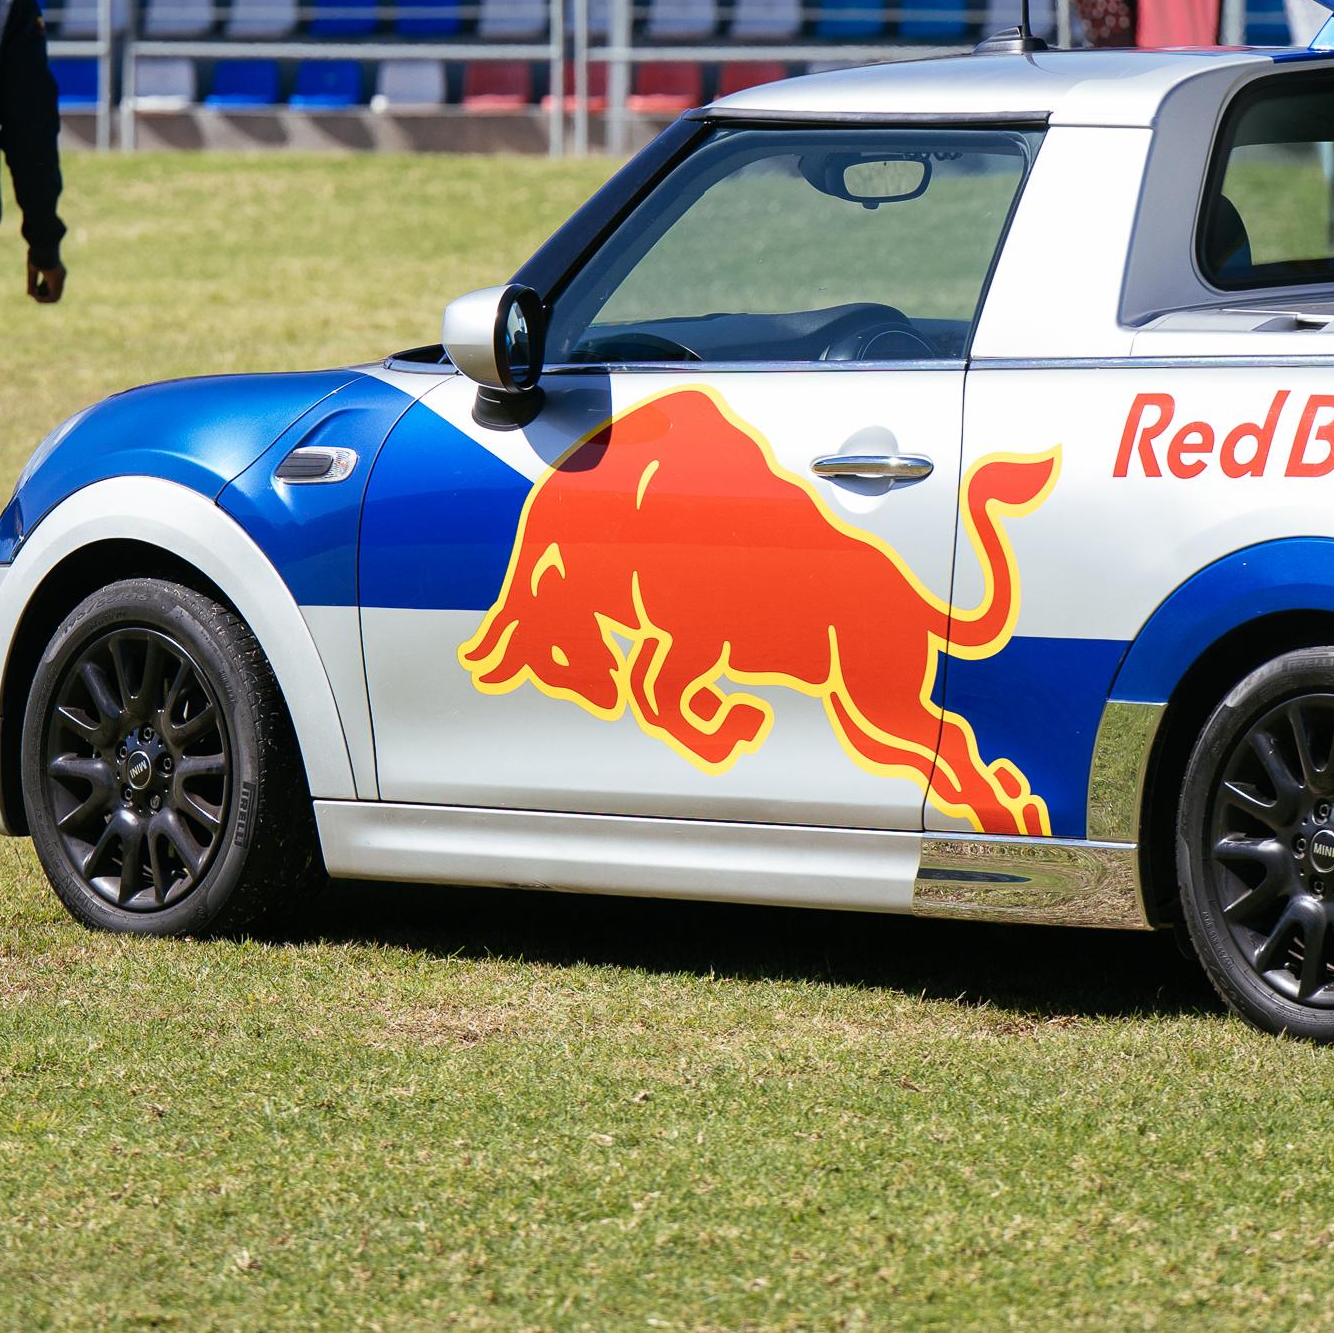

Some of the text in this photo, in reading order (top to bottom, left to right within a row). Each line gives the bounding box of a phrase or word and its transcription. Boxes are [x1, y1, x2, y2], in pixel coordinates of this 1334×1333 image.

[1112, 389, 1292, 480] Red
[130, 760, 148, 779] MINI
[233, 781, 256, 849] PIRELLI
